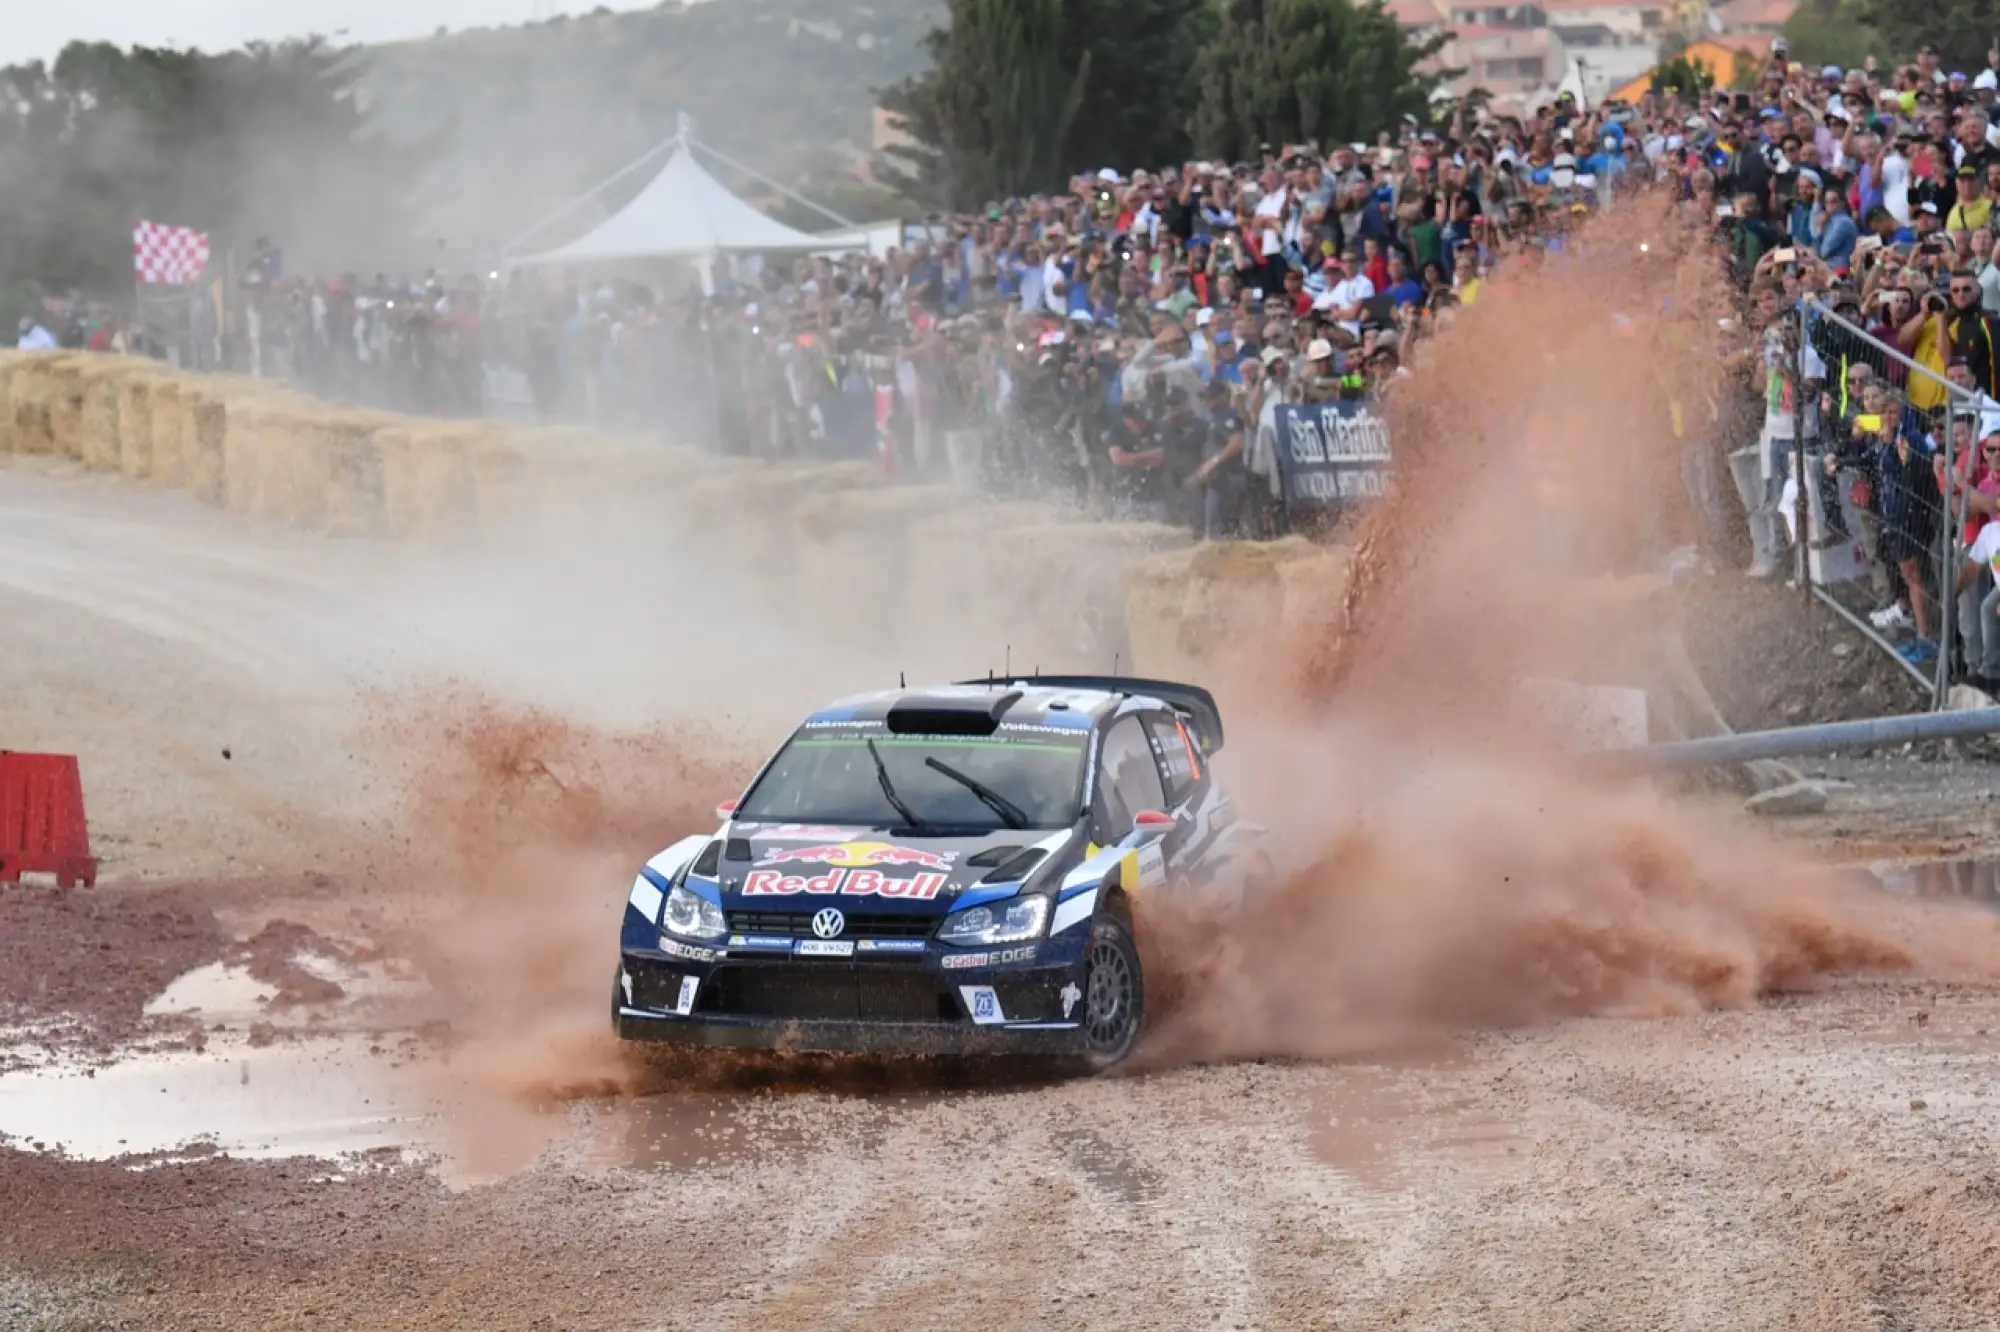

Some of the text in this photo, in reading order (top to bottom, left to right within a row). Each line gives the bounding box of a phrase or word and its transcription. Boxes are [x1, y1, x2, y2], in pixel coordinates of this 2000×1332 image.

[1288, 408, 1325, 462] San
[1000, 722, 1089, 735] Volkswagen
[742, 868, 948, 899] Red Bull
[677, 943, 715, 962] EDGE
[990, 945, 1036, 965] EDGE
